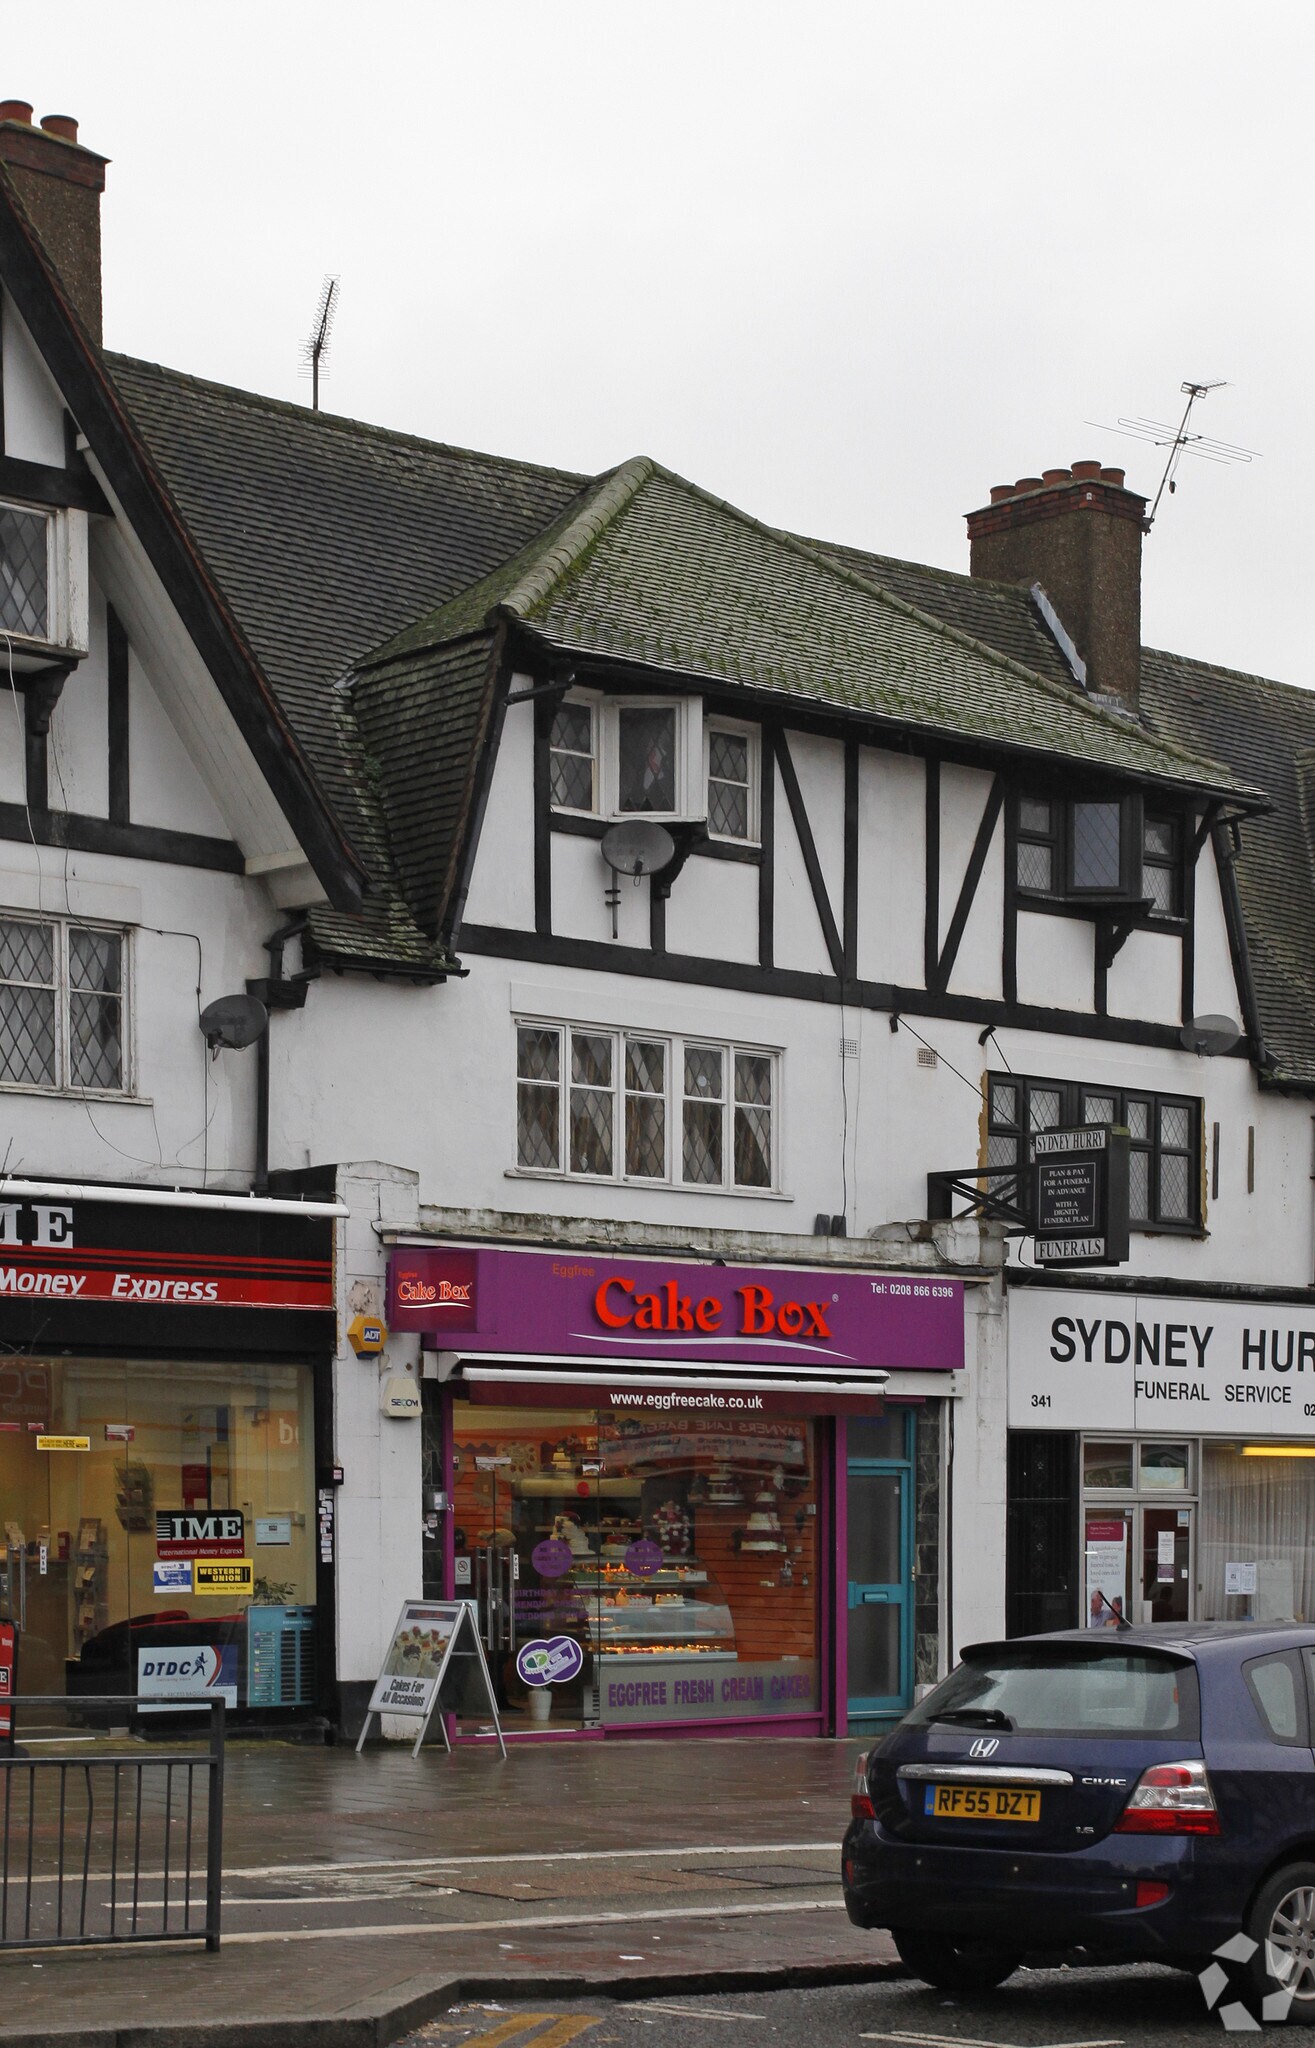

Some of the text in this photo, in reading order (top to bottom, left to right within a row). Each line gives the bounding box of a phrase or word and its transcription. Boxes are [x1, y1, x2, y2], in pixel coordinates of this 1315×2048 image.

[1037, 1131, 1105, 1152] SYDNEY HURRY
[1049, 1169, 1065, 1177] PLAN
[1072, 1168, 1086, 1176] PAY
[1043, 1179, 1056, 1187] FOR
[1063, 1177, 1091, 1185] FUNERAL
[1048, 1187, 1086, 1196] IN ADVANCE
[1044, 1215, 1089, 1224] FUNERAL PLAN
[1053, 1208, 1080, 1216] DIGNITY
[1039, 1239, 1101, 1258] FUNERALS
[552, 1263, 595, 1279] Eggfree
[0, 1268, 219, 1301] Money Express
[397, 1281, 470, 1300] Cake Box
[870, 1282, 953, 1298] Tel: 0208 866 6396
[594, 1276, 834, 1338] Cake Box
[364, 1331, 380, 1340] ADT
[1050, 1317, 1315, 1373] SYDNEY HUR
[1134, 1380, 1292, 1404] FUNERAL SERVICE
[391, 1398, 419, 1407] SECOM
[610, 1392, 763, 1410] www.eggfreecake.co.uk
[1031, 1395, 1052, 1408] 341
[171, 1516, 242, 1541] IME
[159, 1548, 198, 1556] International
[199, 1567, 241, 1575] WESTERN
[143, 1661, 192, 1677] DTDC
[390, 1679, 425, 1693] Cakes For
[608, 1674, 810, 1708] EGGFREE FRESH CREAM CAKES
[380, 1691, 425, 1707] All Occasions
[1081, 1777, 1126, 1786] CIVIC
[938, 1788, 1037, 1816] RF55 DZT
